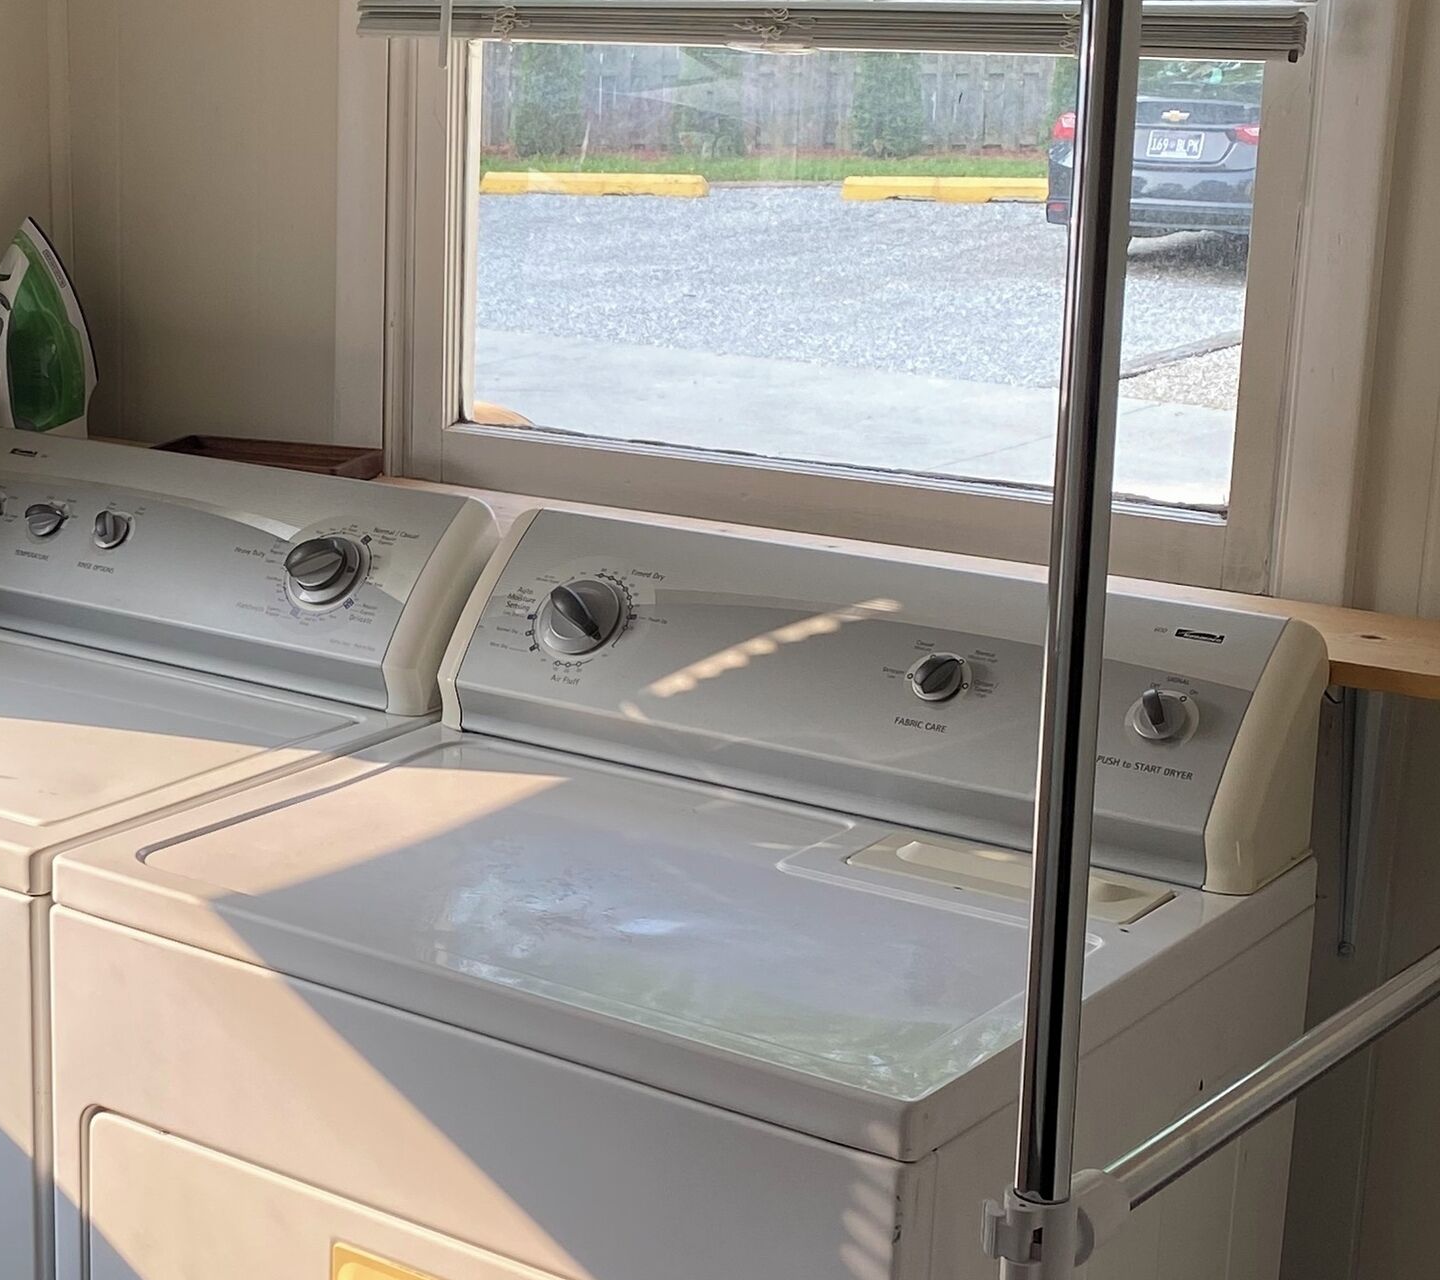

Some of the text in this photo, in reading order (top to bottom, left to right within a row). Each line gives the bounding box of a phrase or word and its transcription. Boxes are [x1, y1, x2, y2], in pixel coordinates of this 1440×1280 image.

[563, 676, 581, 686] Fluff
[894, 716, 948, 734] FABRIC CARE
[1096, 754, 1194, 781] PUSH to START DRYER
